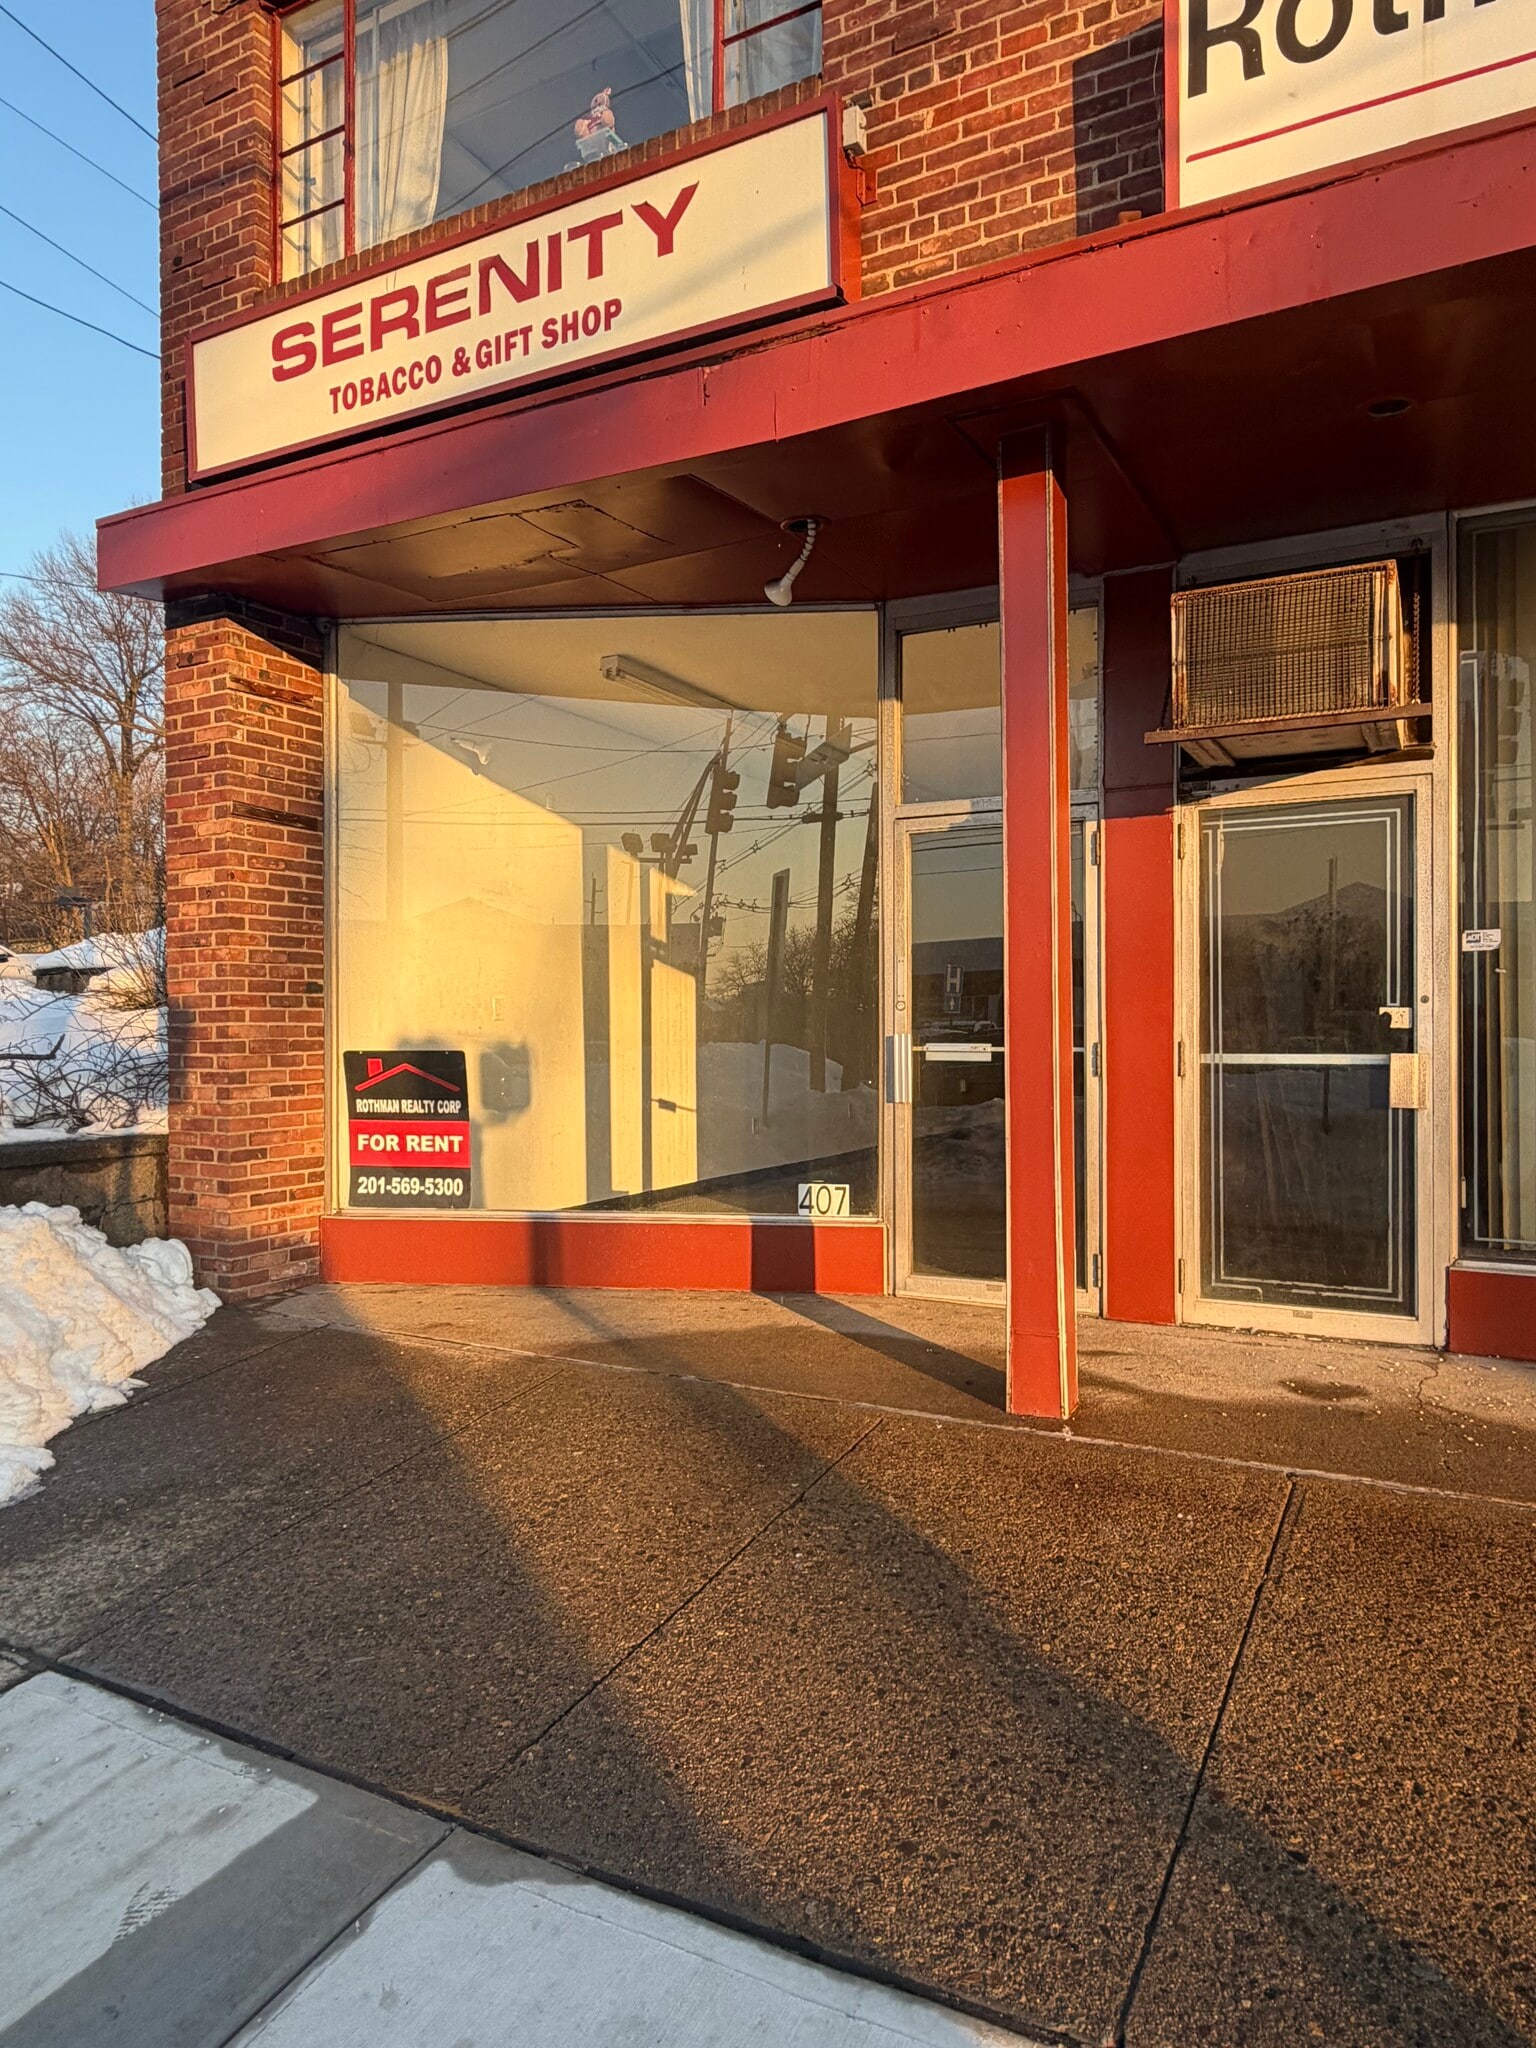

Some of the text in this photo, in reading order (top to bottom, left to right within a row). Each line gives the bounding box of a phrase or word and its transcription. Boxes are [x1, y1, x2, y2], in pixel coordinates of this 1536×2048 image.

[272, 181, 699, 382] SERENITY
[330, 299, 621, 414] TOBACCO & GIFT SHOP
[356, 1099, 461, 1114] ROTHMAN REALTY CORP
[357, 1134, 463, 1153] FOR RENT
[357, 1176, 463, 1196] 201-569-5300
[799, 1186, 847, 1215] 407
